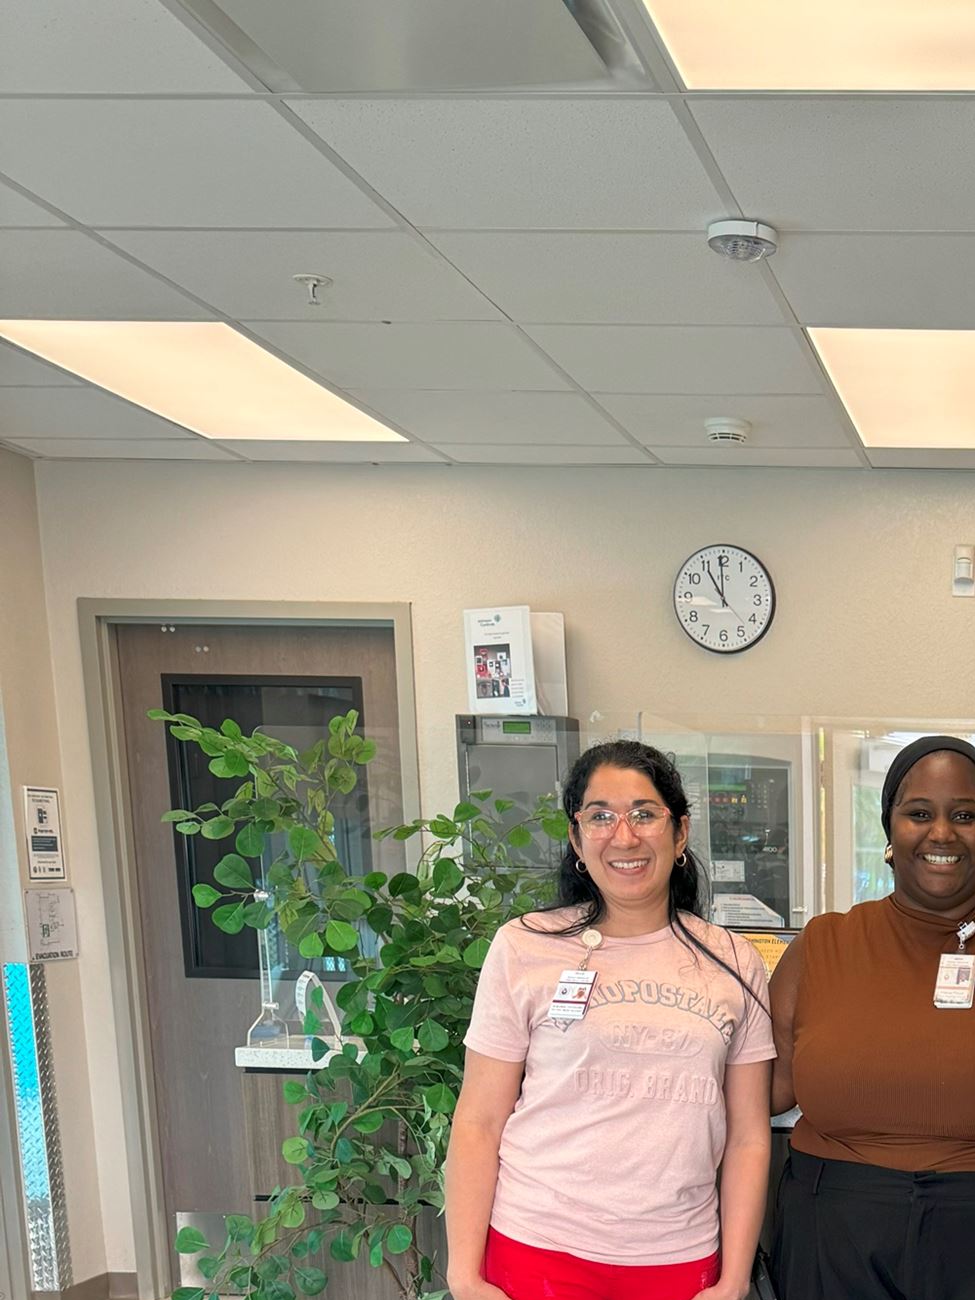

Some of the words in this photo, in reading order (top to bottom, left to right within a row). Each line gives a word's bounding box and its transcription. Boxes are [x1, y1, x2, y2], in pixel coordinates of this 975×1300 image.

[701, 560, 710, 571] 11
[739, 561, 743, 573] 1
[688, 573, 701, 585] 10
[749, 575, 758, 587] 2
[684, 591, 693, 603] 9
[753, 594, 762, 606] 3
[689, 610, 698, 622] 8
[748, 613, 756, 624] 4
[702, 624, 710, 636] 7
[719, 629, 728, 641] 6
[737, 626, 745, 637] 5
[643, 1068, 719, 1106] BRAND
